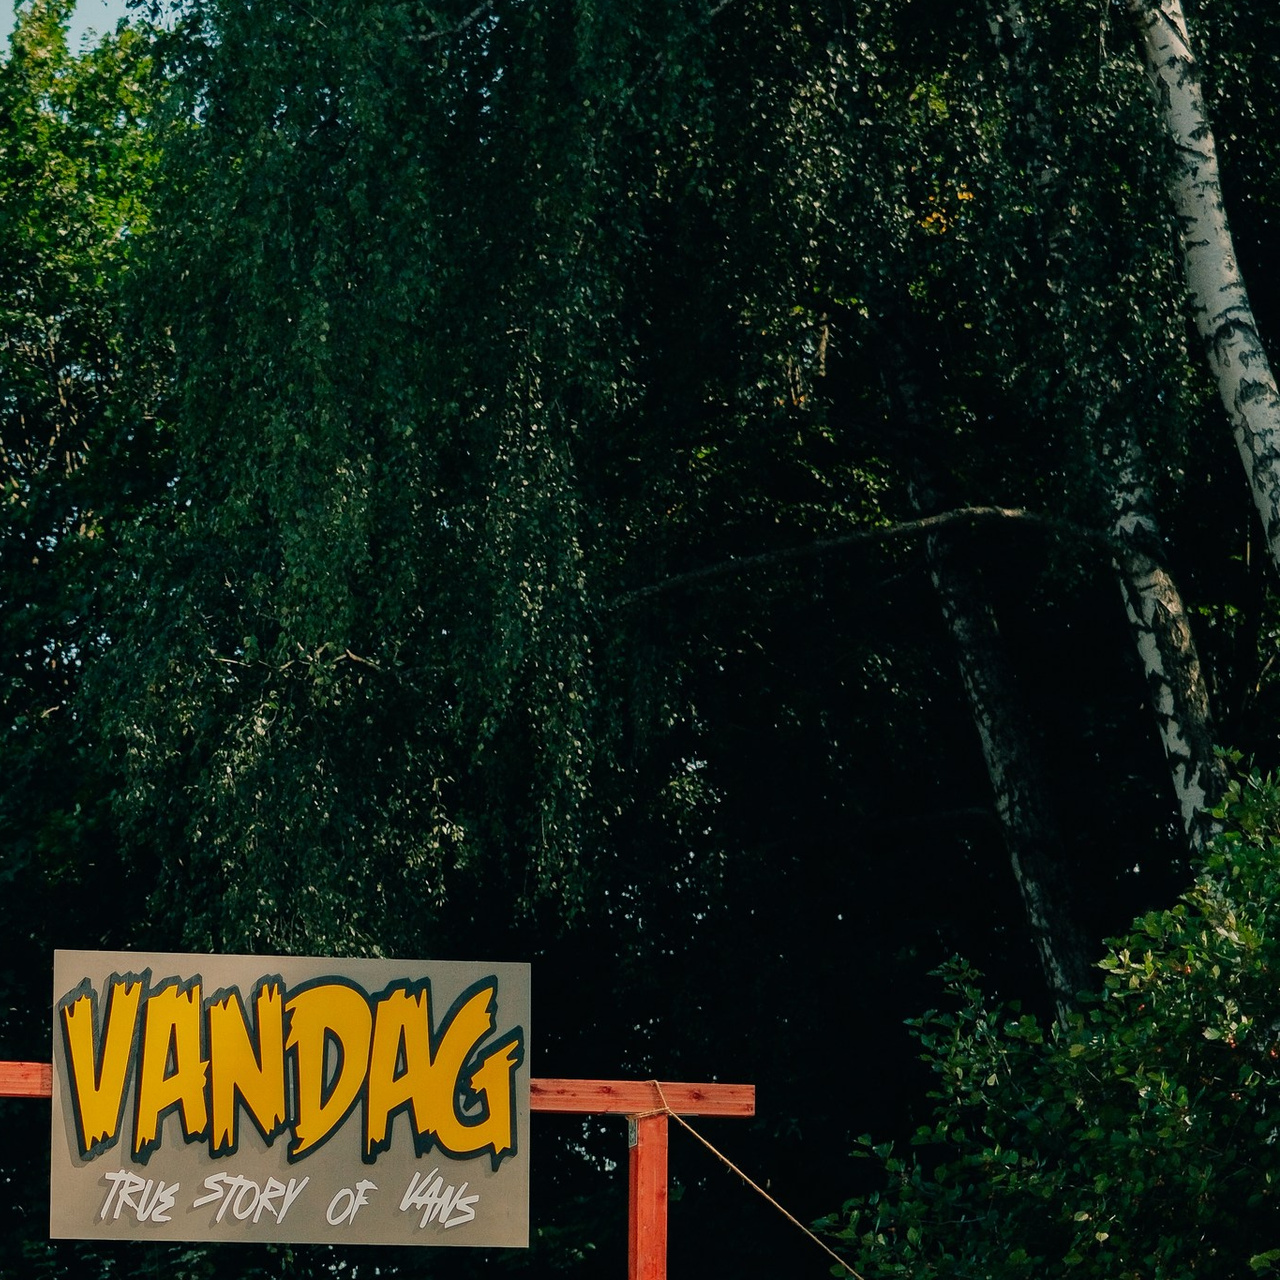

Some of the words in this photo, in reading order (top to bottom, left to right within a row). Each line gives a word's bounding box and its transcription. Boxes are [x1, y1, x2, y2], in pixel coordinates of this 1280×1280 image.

[59, 968, 524, 1171] VANDAG
[100, 1169, 180, 1222] TRUE
[194, 1172, 310, 1224] STORY
[327, 1179, 379, 1225] OF
[399, 1167, 480, 1229] VANS
